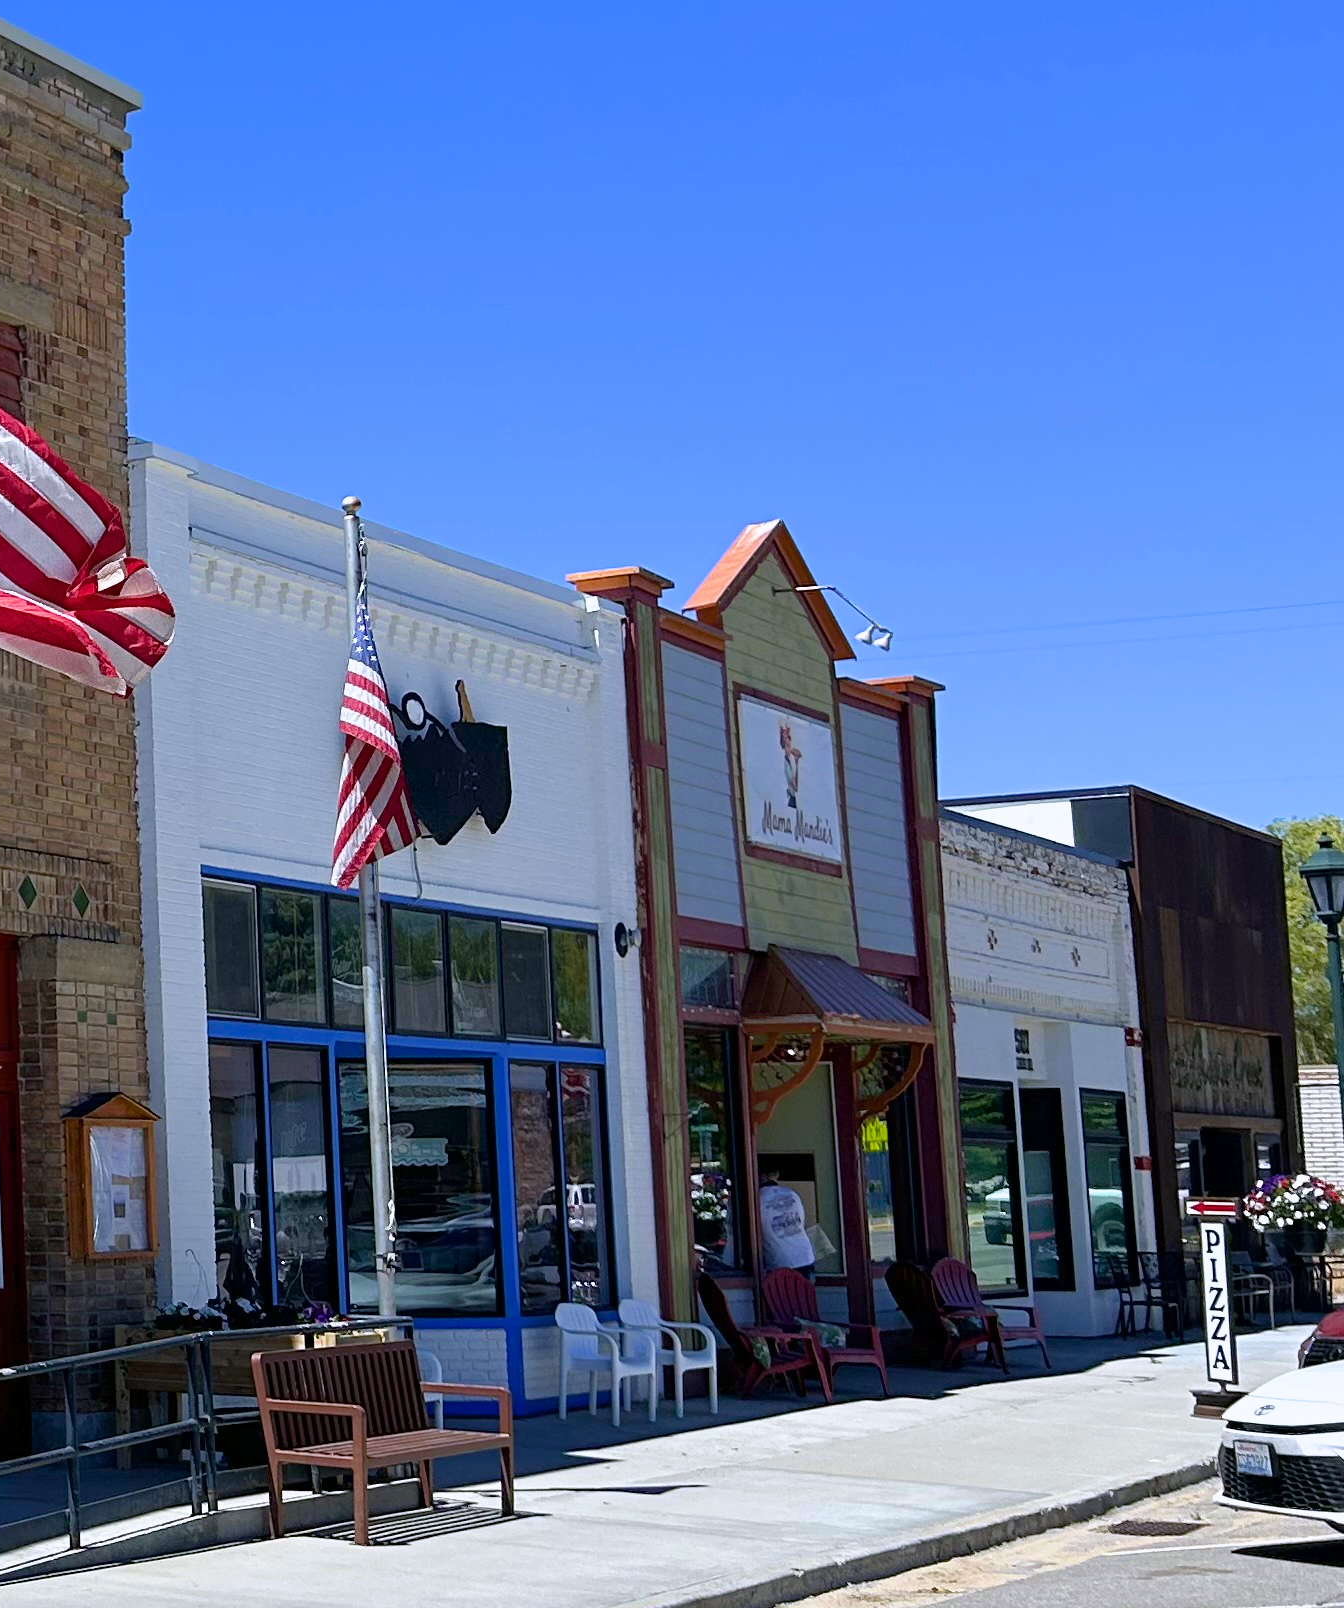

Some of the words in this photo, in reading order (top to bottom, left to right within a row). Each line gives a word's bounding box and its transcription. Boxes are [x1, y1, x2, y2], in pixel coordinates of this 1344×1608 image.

[762, 800, 792, 836] Mama
[794, 808, 833, 845] Mandie's
[397, 1143, 443, 1156] OPEN
[1204, 1229, 1230, 1370] PIZZA
